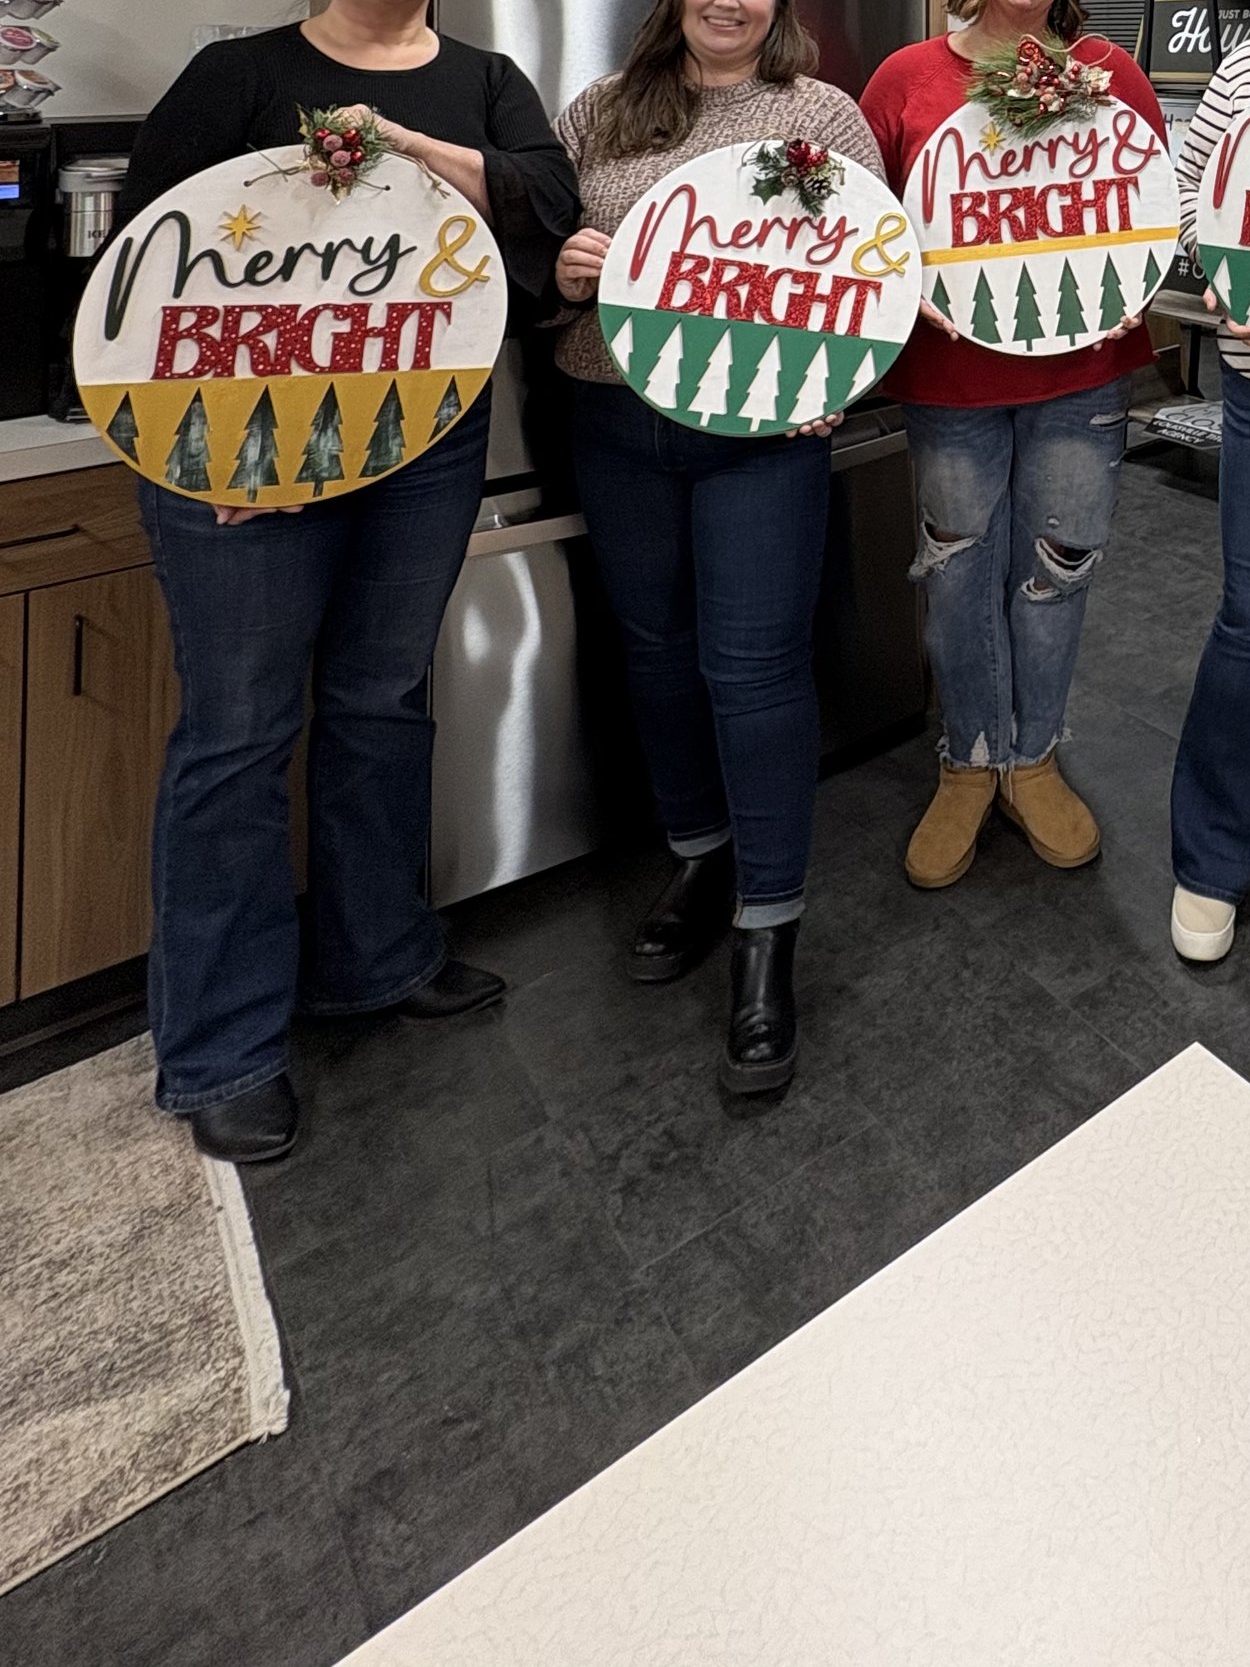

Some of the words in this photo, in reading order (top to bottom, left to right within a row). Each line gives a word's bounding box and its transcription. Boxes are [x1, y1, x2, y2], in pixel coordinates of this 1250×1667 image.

[1218, 10, 1240, 19] JUST
[922, 127, 1109, 224] Merry
[1112, 110, 1161, 175] &
[630, 184, 859, 282] Merry
[852, 212, 910, 277] &
[950, 176, 1140, 248] BRIGHT
[105, 210, 417, 341] Merry
[419, 215, 490, 298] &
[655, 251, 883, 338] BRIGHT
[150, 301, 452, 380] BRIGHT
